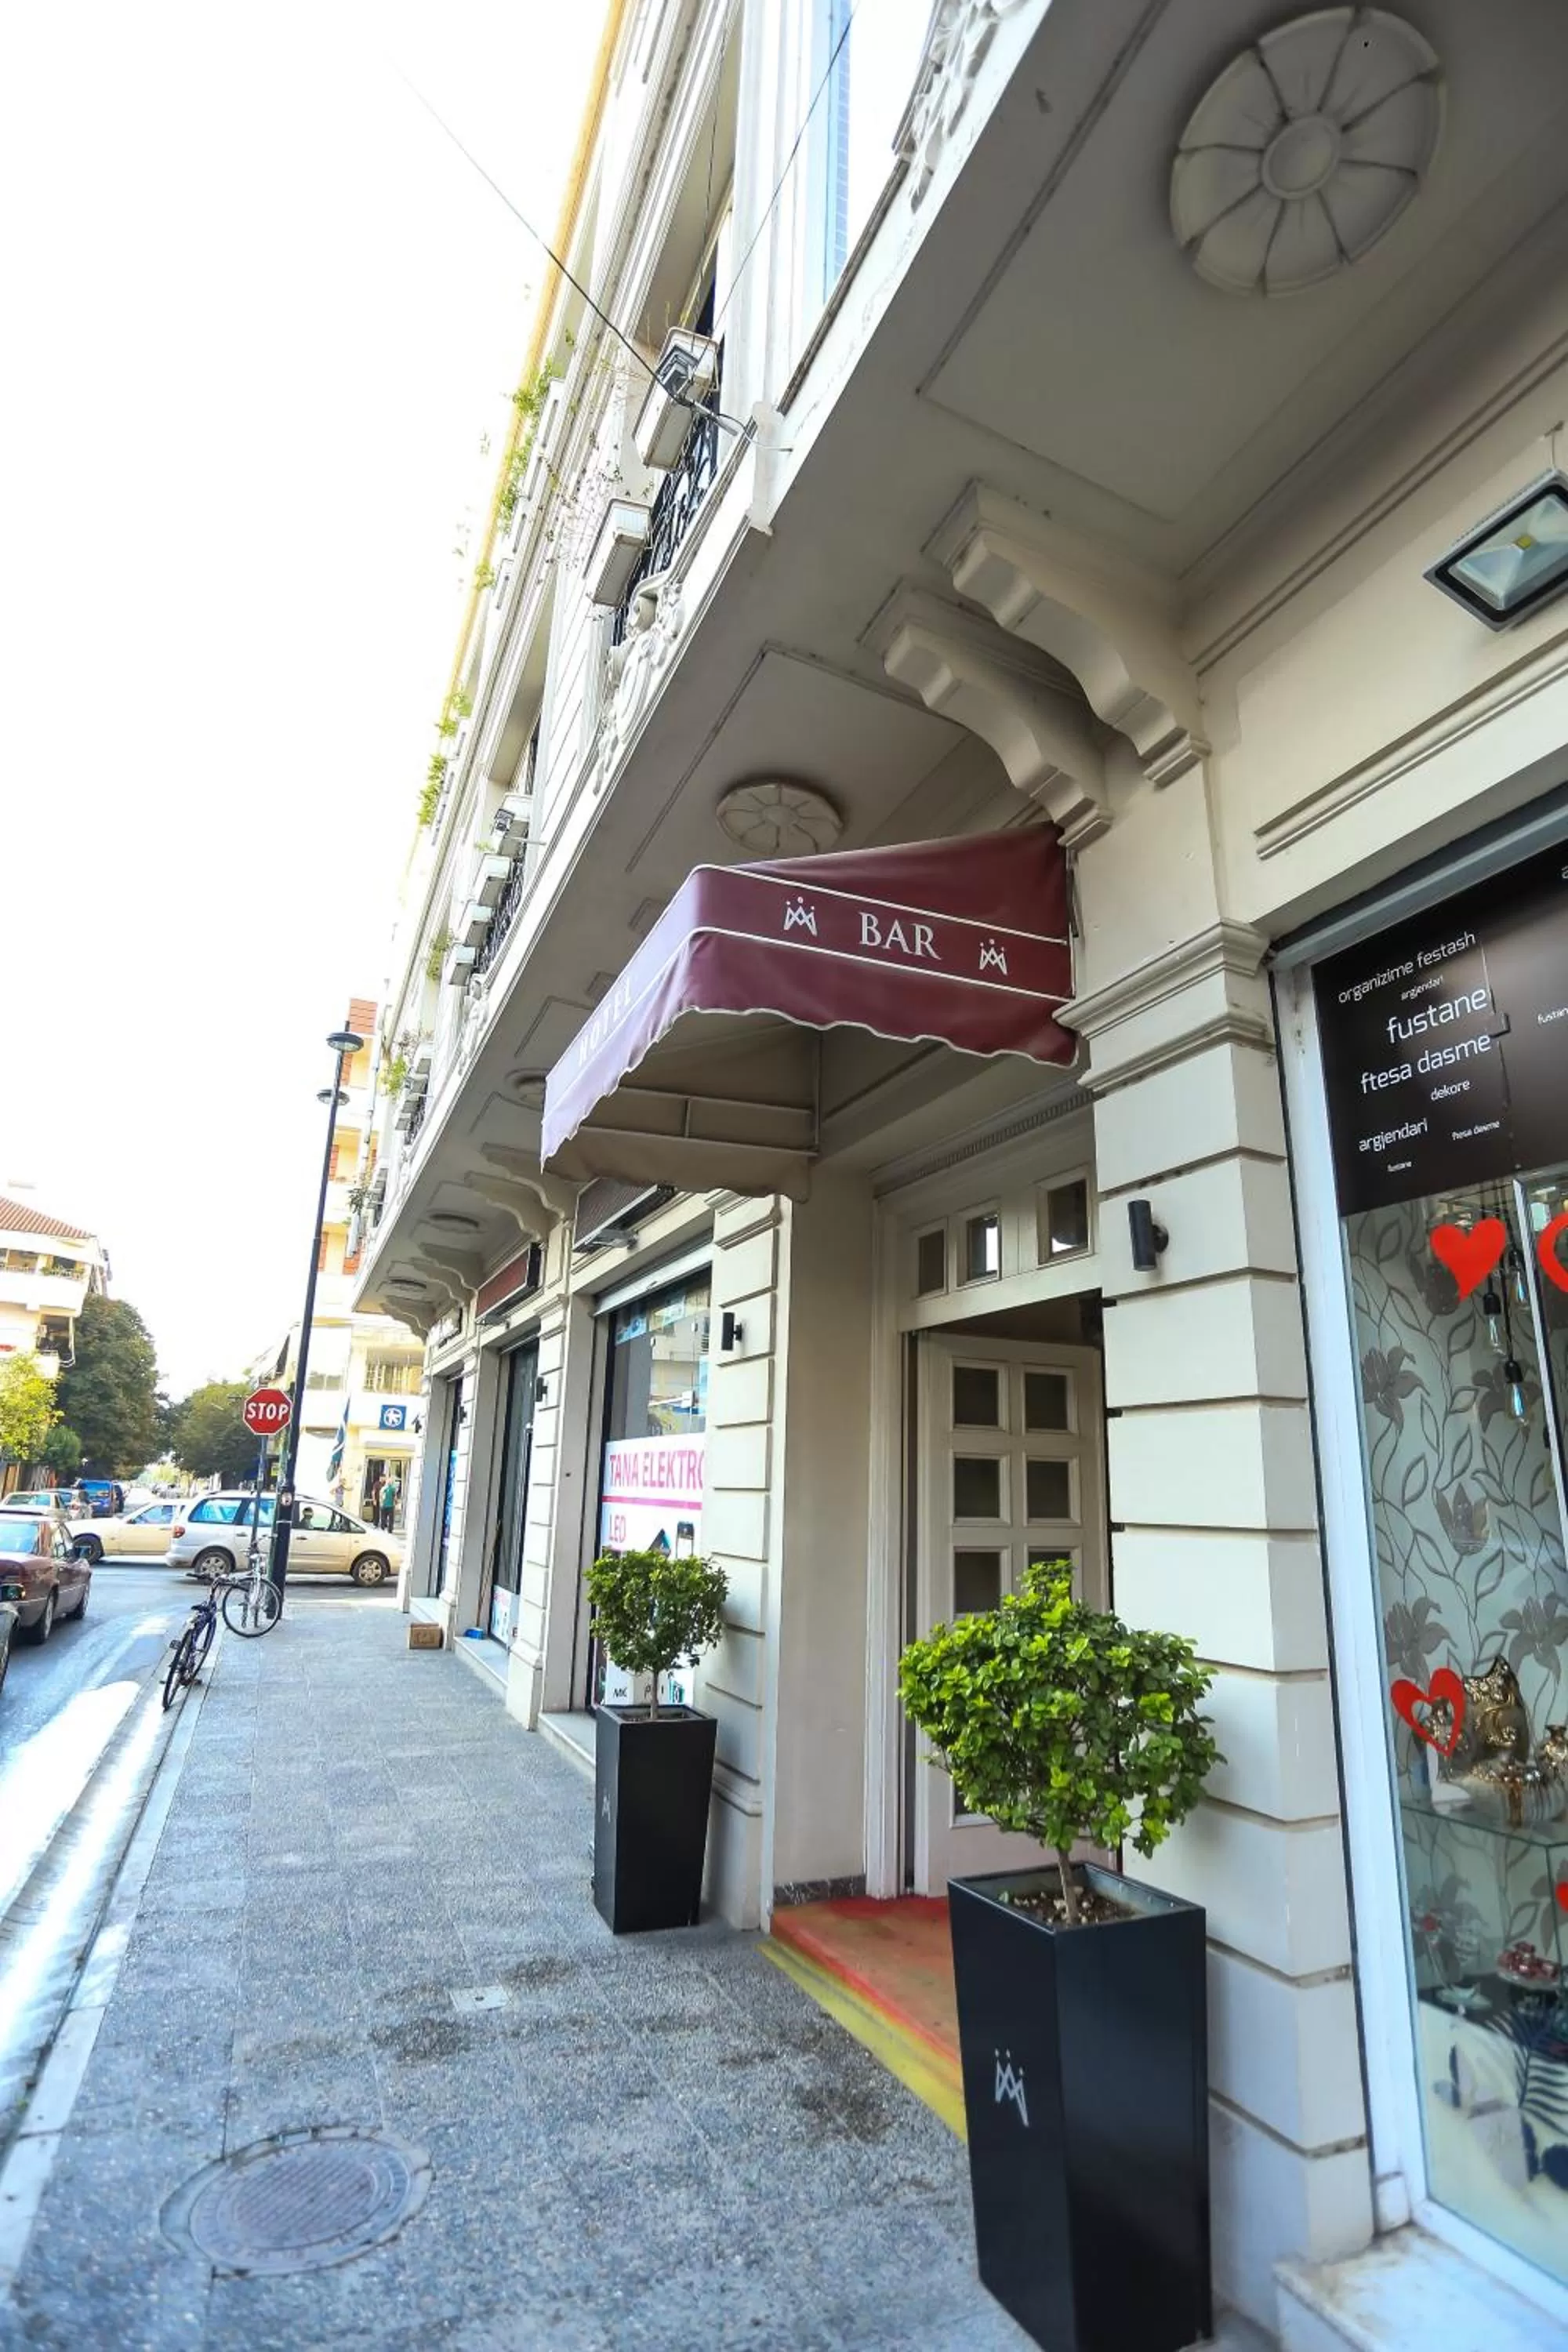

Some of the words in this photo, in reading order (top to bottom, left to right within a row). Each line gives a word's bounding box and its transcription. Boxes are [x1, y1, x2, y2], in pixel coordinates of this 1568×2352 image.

[858, 911, 942, 960] BAR
[1338, 961, 1414, 1004] organizime
[1417, 931, 1476, 969] festash
[1386, 988, 1487, 1044] fustane
[1360, 1063, 1413, 1094] ftesa
[1417, 1033, 1492, 1074] dasme
[1430, 1080, 1471, 1102] dekore
[1359, 1117, 1428, 1152] argjendari
[246, 1402, 289, 1421] STOP
[609, 1452, 640, 1488] TANA
